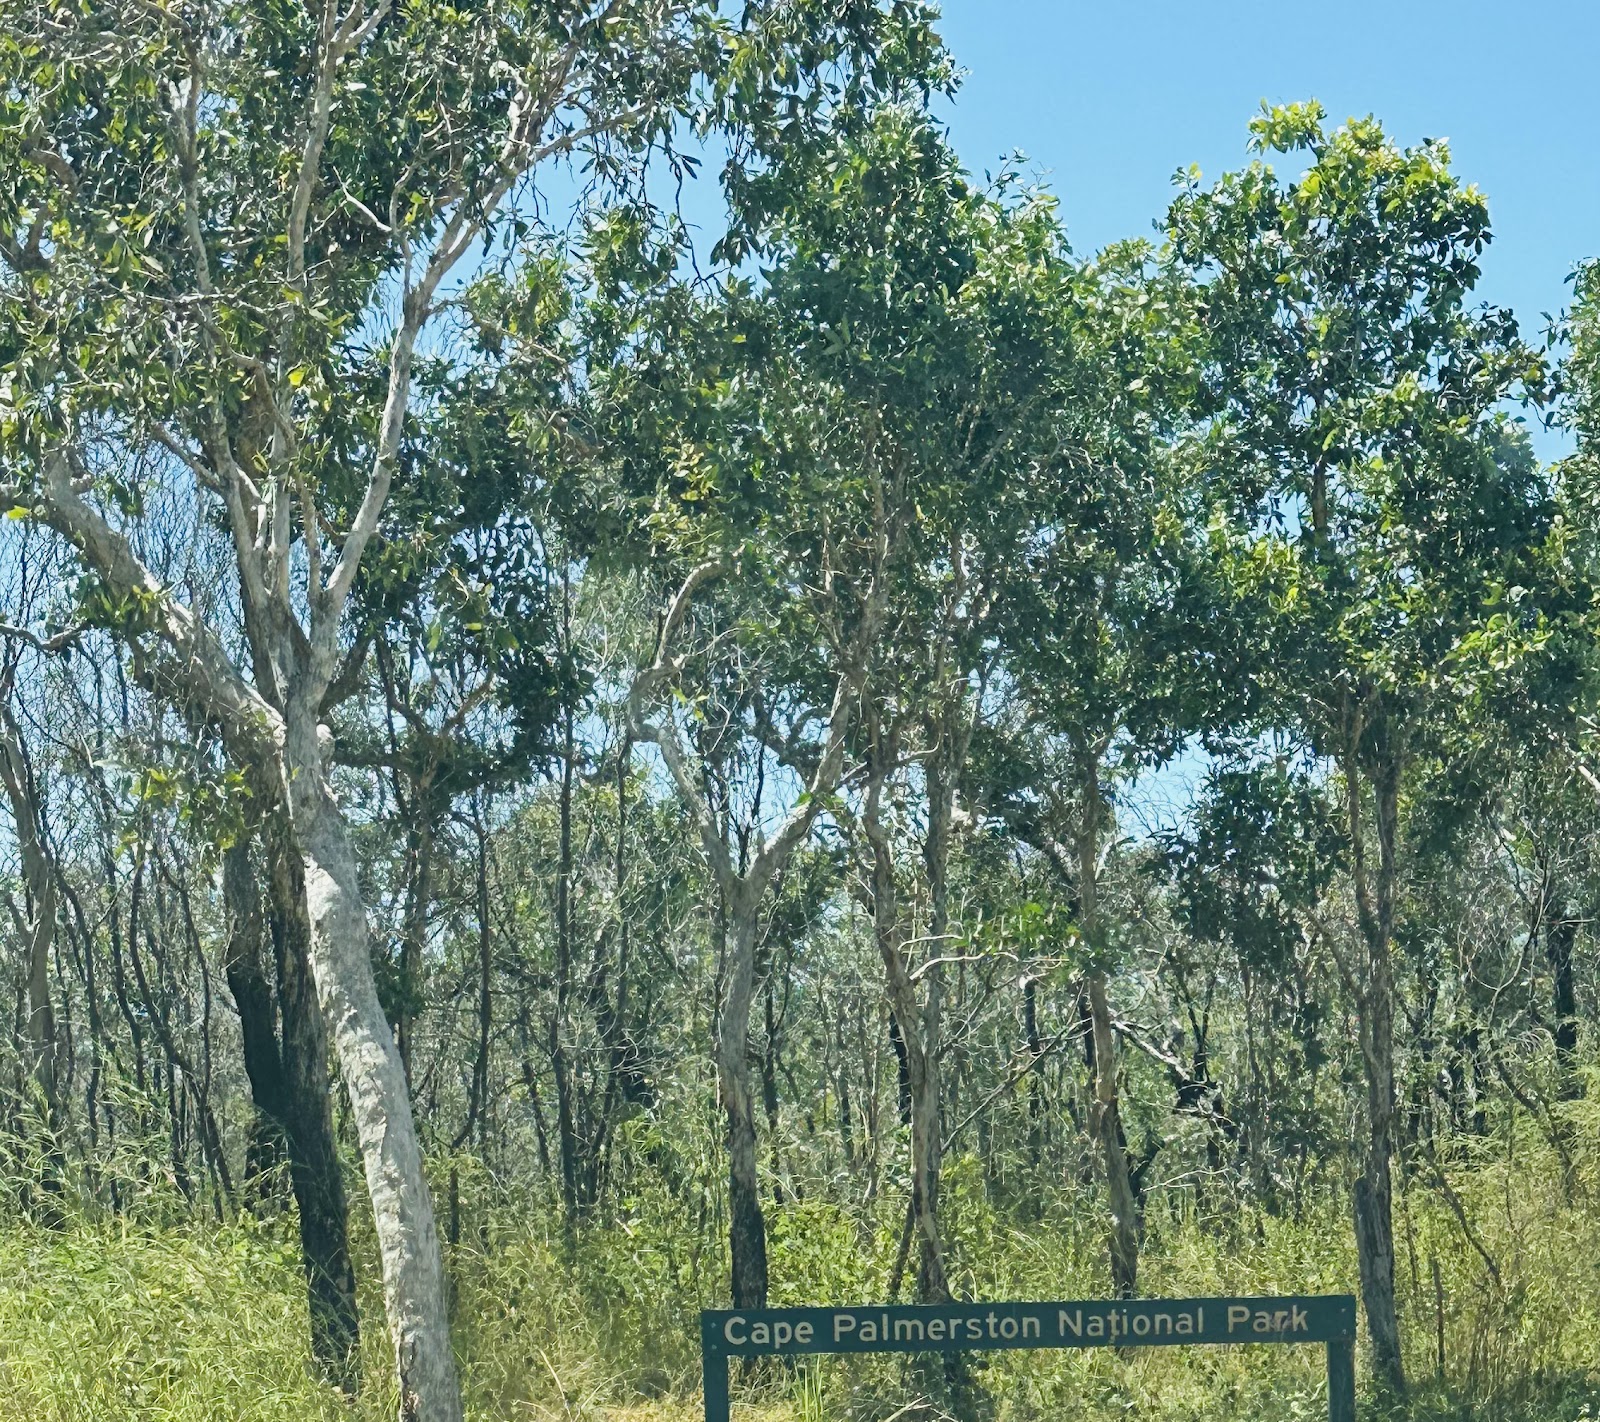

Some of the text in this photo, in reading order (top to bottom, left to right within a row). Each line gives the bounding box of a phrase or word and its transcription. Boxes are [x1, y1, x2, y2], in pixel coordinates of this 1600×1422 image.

[724, 1304, 1309, 1349] Cape Palmerston National Park
